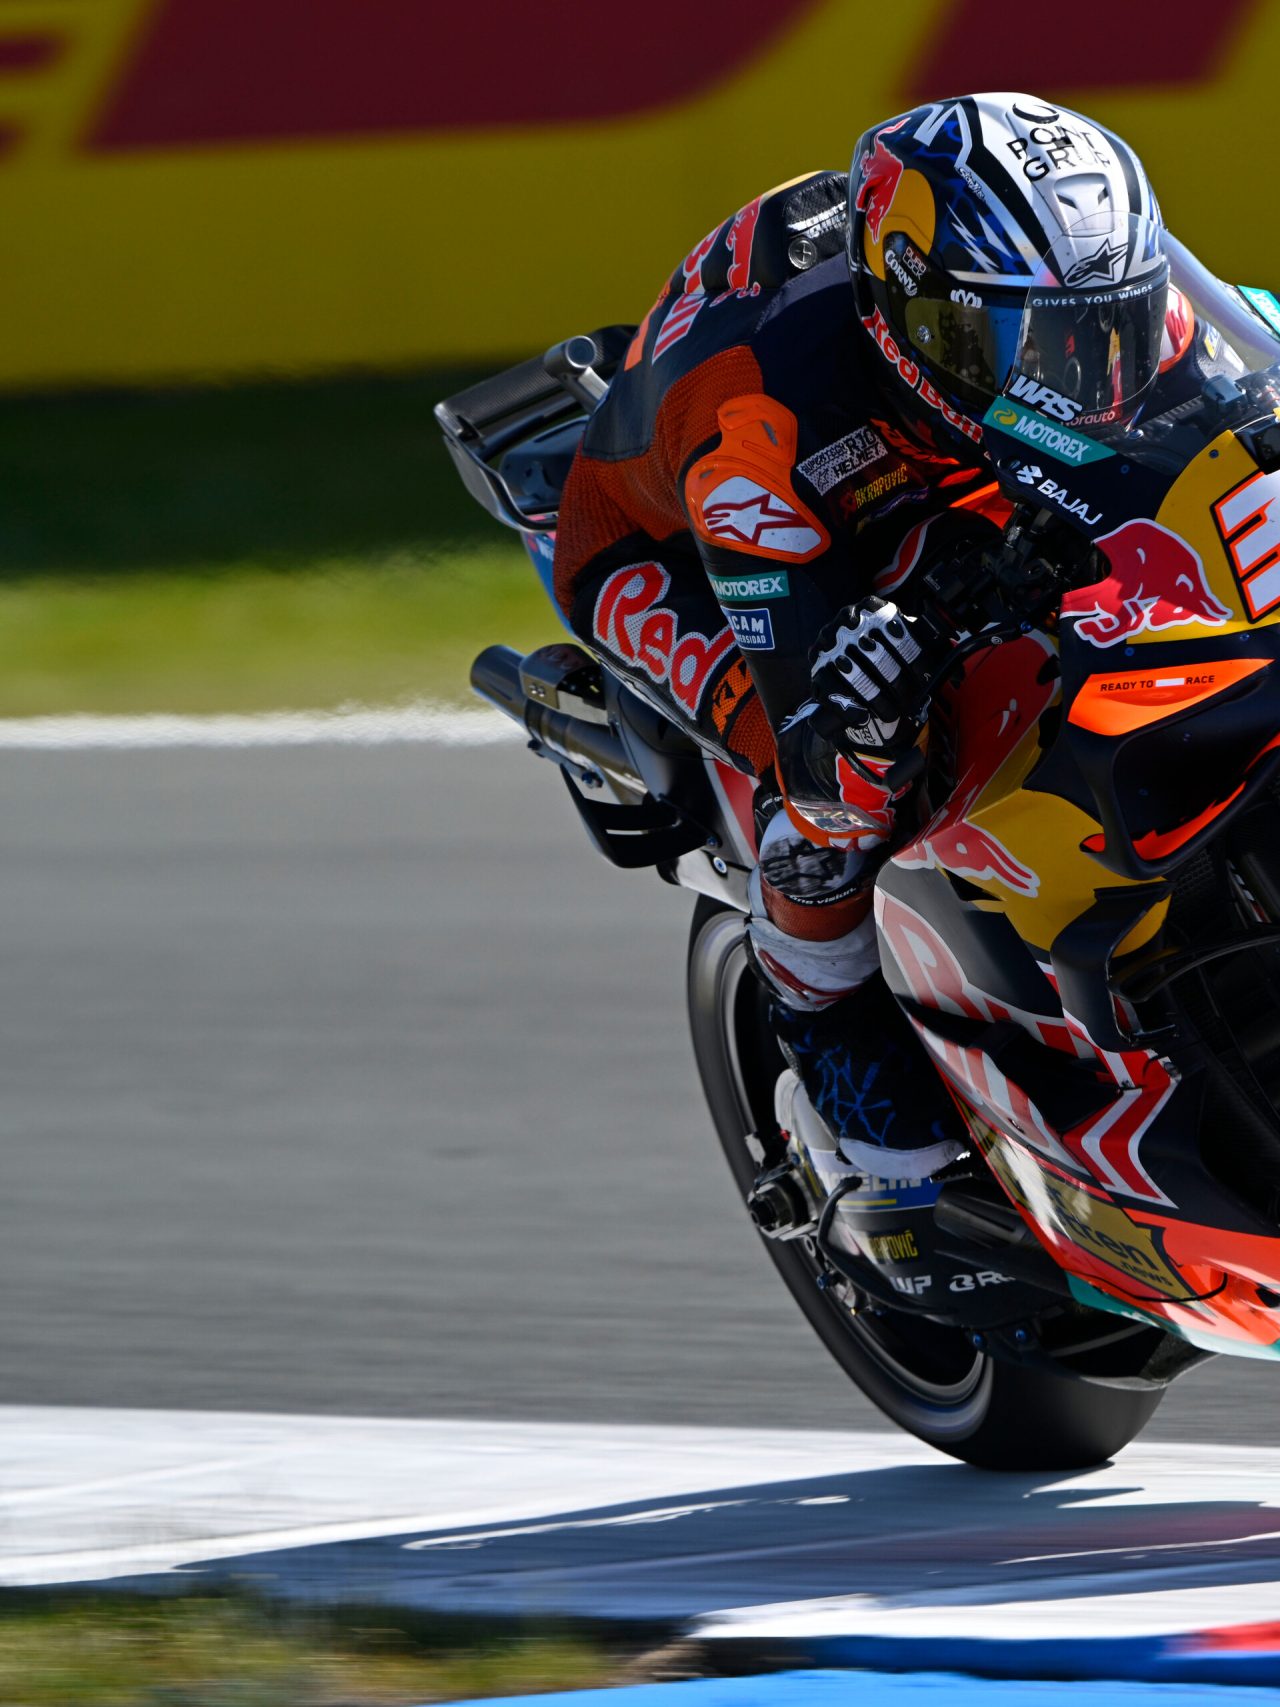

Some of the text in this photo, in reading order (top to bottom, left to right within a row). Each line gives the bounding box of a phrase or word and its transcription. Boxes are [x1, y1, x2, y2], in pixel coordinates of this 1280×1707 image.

[1032, 284, 1153, 308] GIVES YOU WINGS
[1008, 374, 1083, 422] WRS
[1061, 410, 1116, 426] orauto
[1013, 415, 1090, 461] MOTOREX
[1037, 478, 1103, 525] BAJAJ
[714, 576, 783, 597] MOTOREX
[729, 615, 764, 634] CAM
[593, 560, 738, 720] Red
[1100, 675, 1216, 692] READY TO RACE
